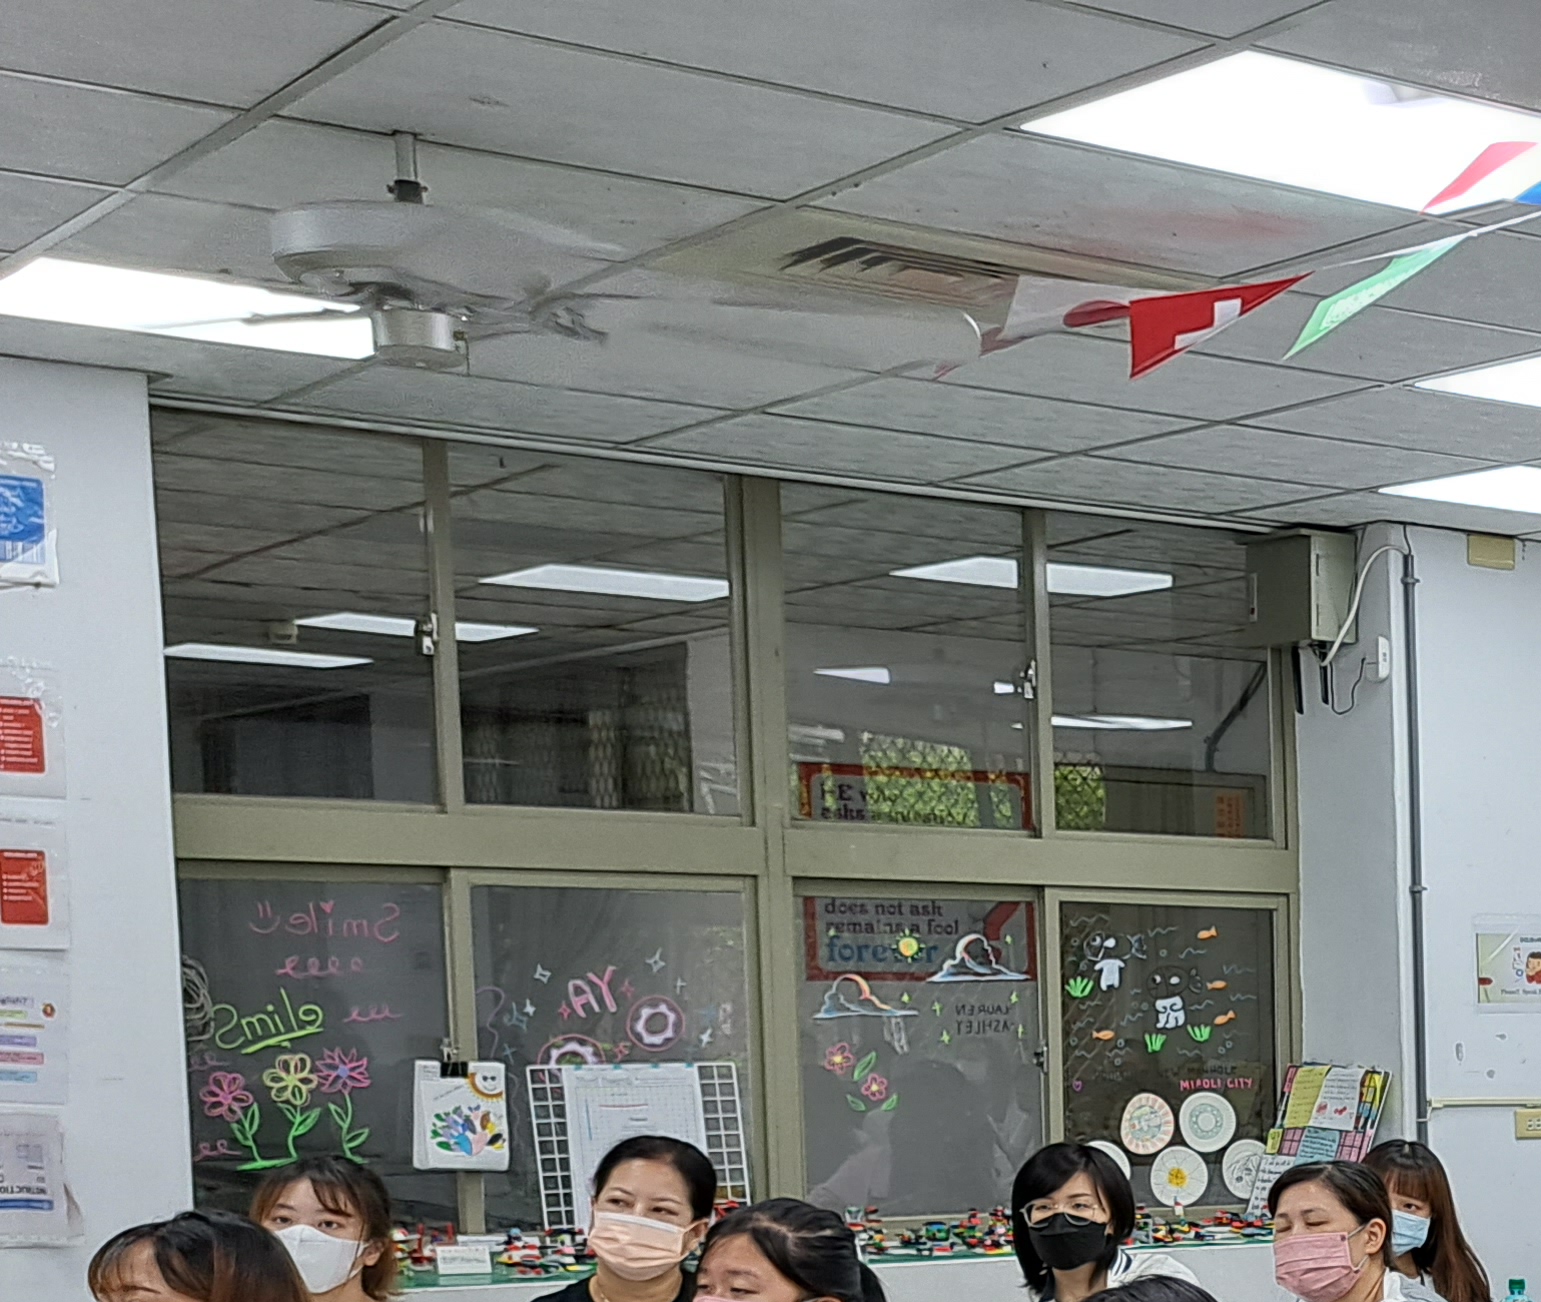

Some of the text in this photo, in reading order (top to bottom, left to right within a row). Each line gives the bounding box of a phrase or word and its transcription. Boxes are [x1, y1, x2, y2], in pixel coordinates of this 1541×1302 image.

[824, 900, 943, 918] does not ask
[927, 919, 960, 936] fool
[210, 986, 324, 1050] Smile
[1226, 1077, 1253, 1090] CITY
